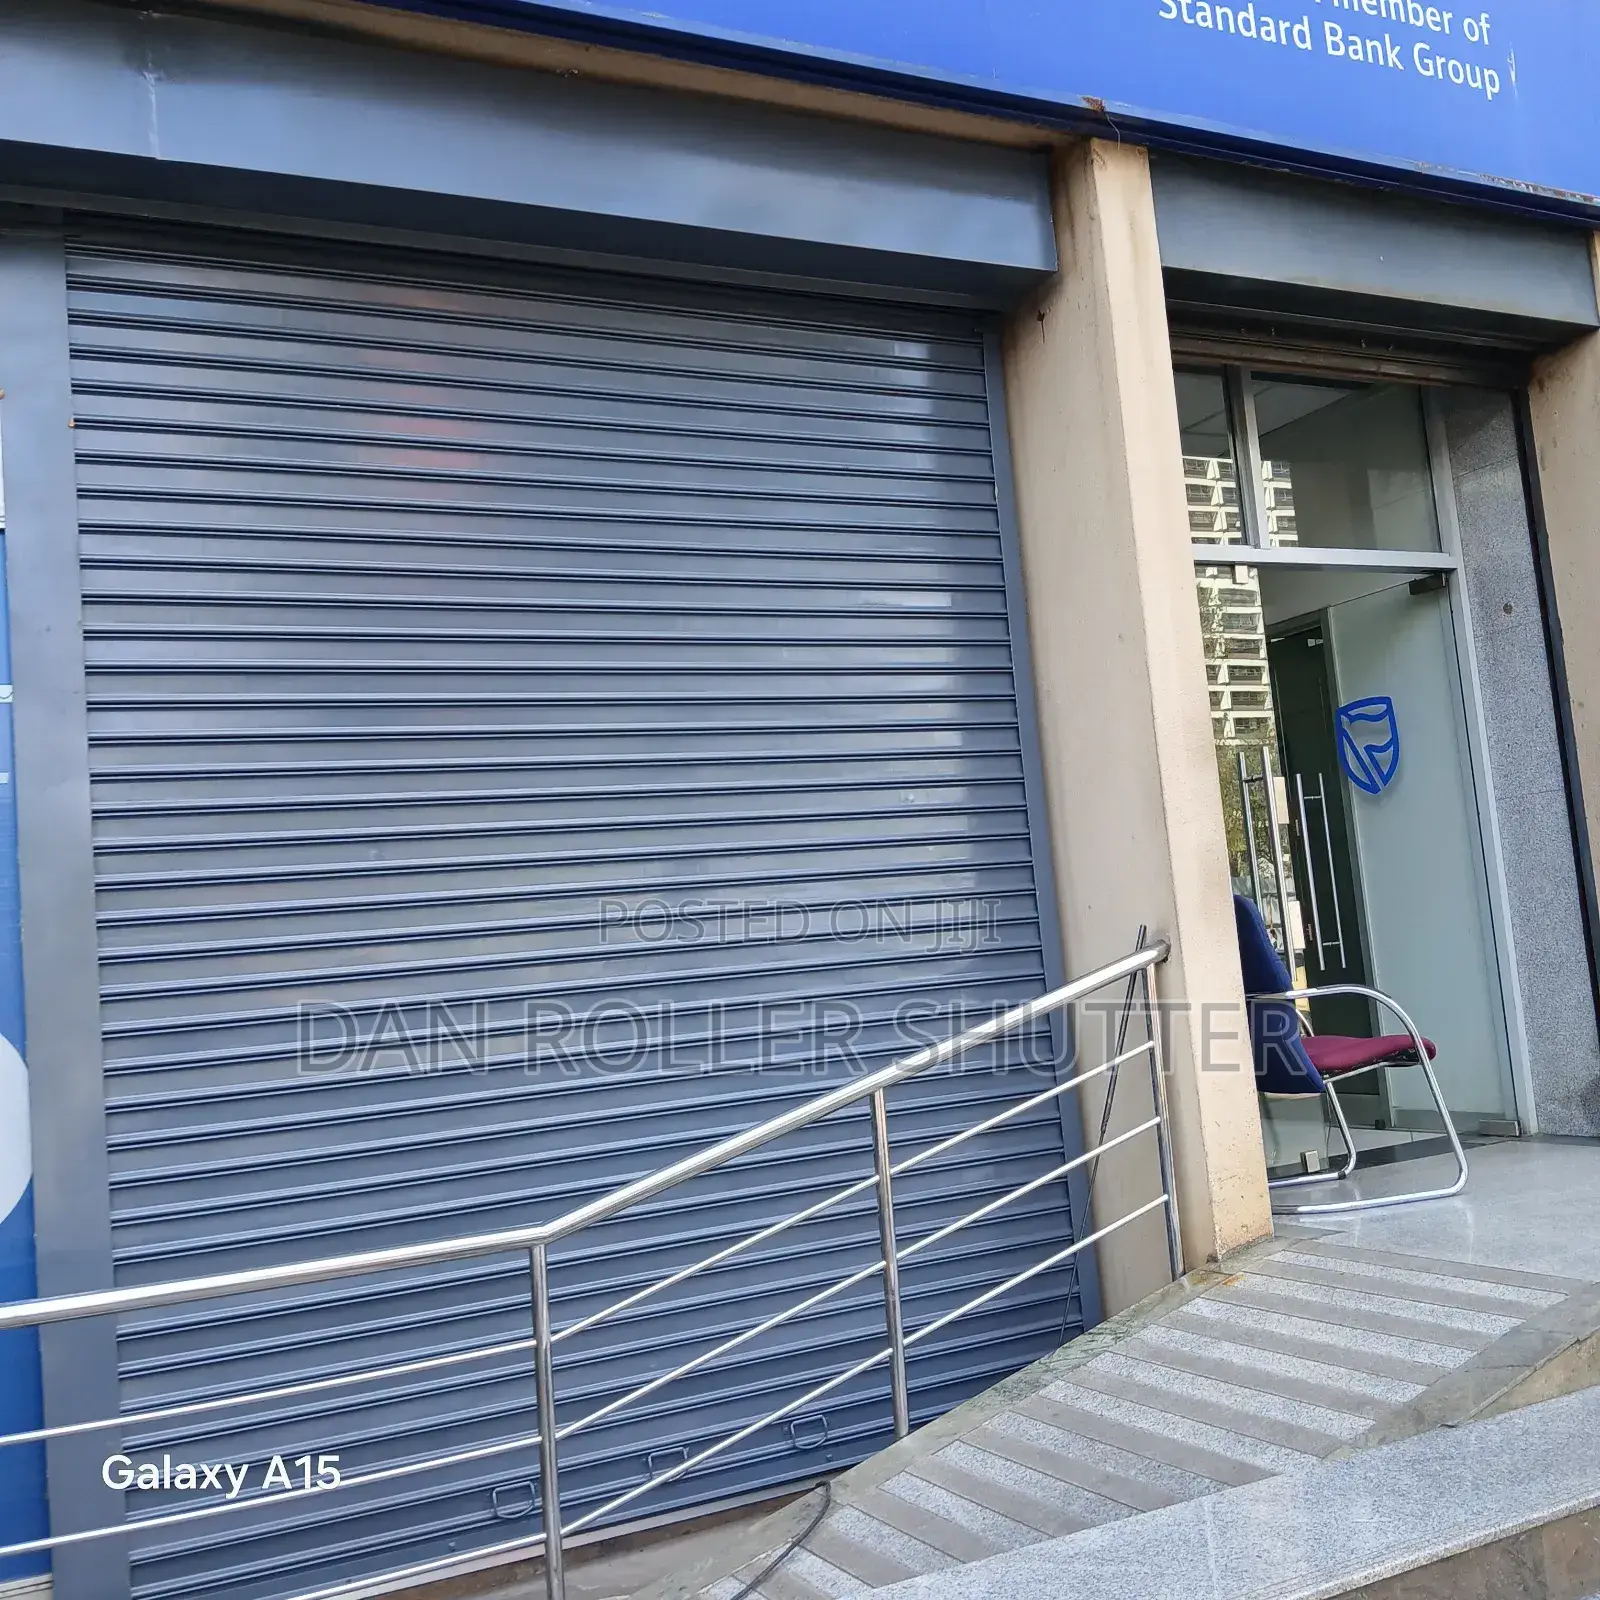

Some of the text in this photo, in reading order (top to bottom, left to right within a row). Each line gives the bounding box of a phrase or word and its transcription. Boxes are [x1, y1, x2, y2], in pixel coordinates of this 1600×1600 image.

[1158, 0, 1501, 101] Standard Bank Group
[1462, 12, 1491, 46] of
